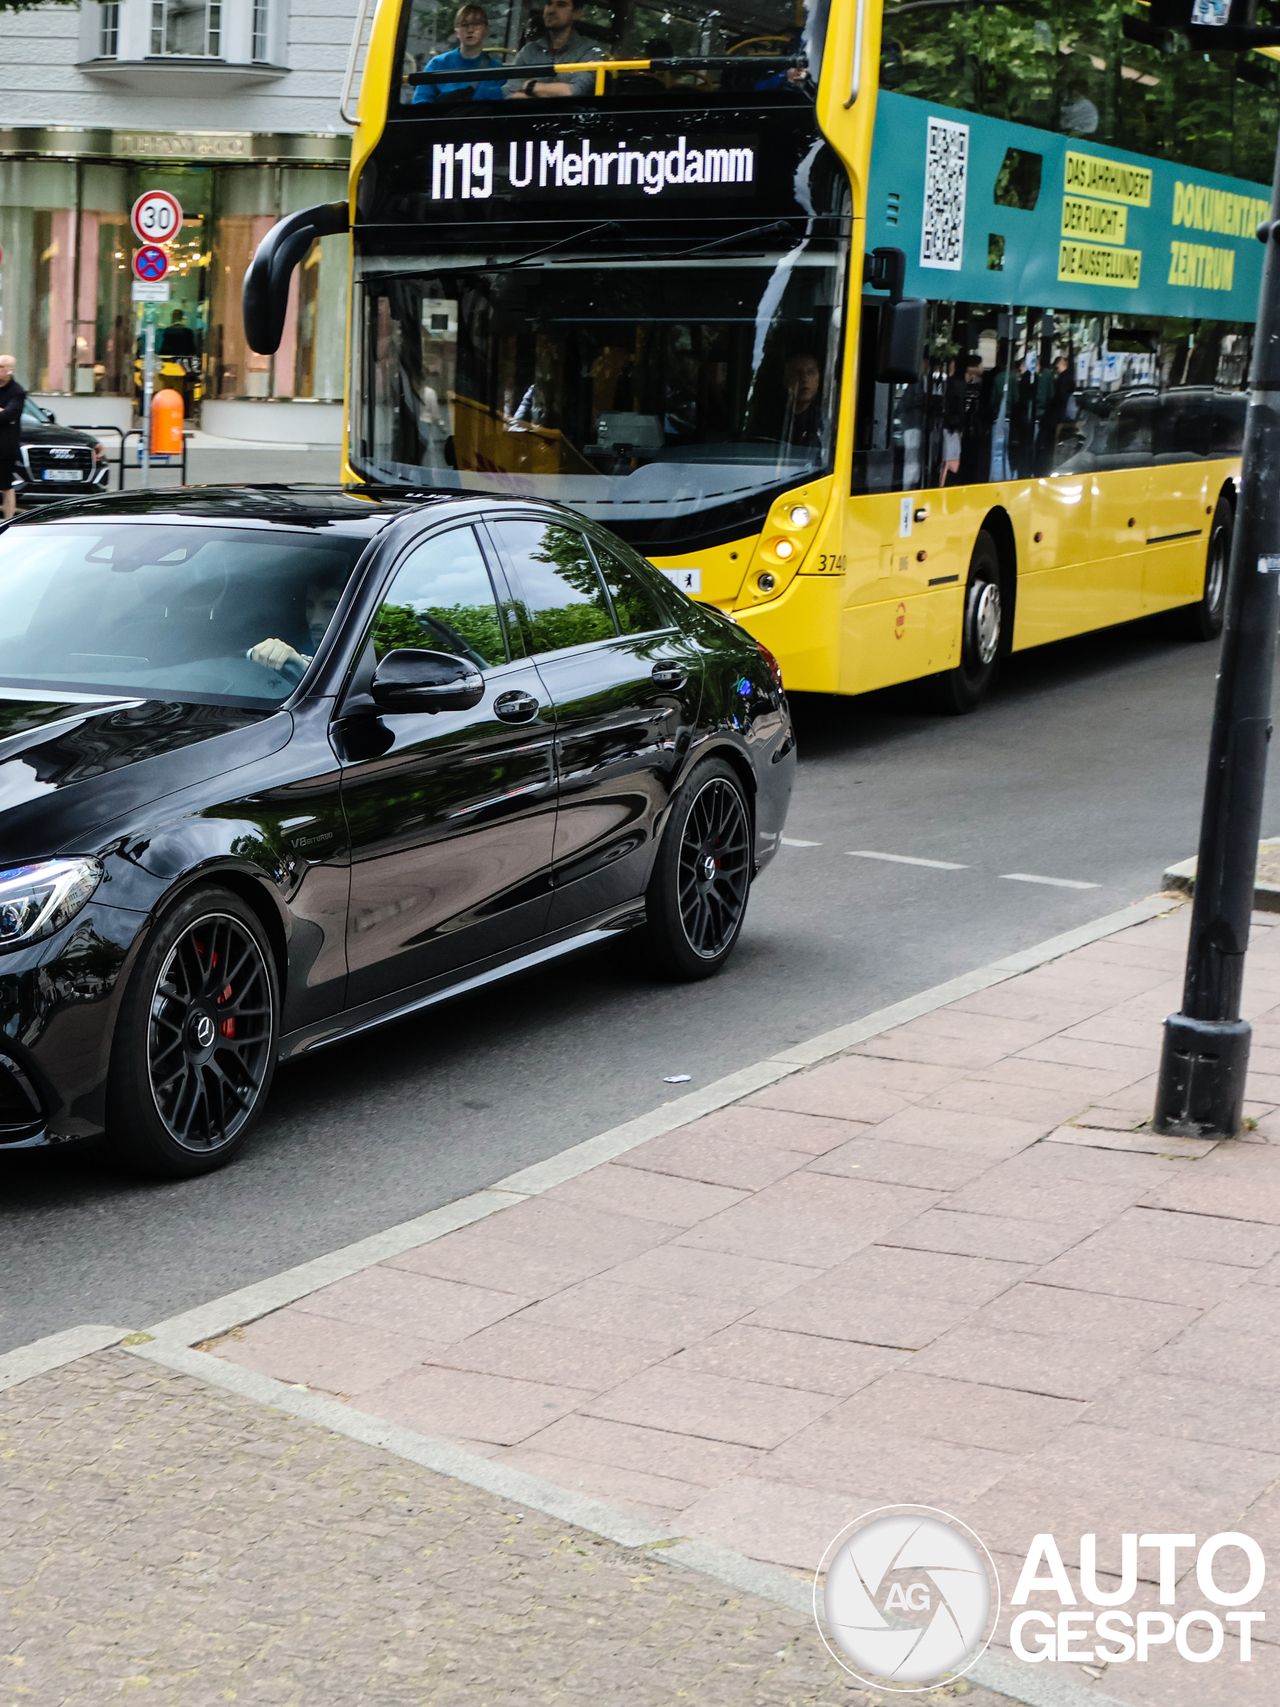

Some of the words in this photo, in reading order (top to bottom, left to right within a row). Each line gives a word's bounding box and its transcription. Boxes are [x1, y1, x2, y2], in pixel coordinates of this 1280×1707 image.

[431, 141, 494, 200] M19
[508, 140, 534, 188] U
[538, 135, 754, 196] Mehringdamm
[1067, 157, 1087, 188] DAS
[1086, 162, 1150, 201] JAHRHUNDERT
[143, 205, 171, 230] 30
[1063, 201, 1083, 232] DER
[1082, 204, 1118, 237] FLUCHT
[1060, 245, 1077, 275] DIE
[1076, 247, 1139, 281] AUSSTELLUNG
[1168, 241, 1235, 291] ZENTRUM
